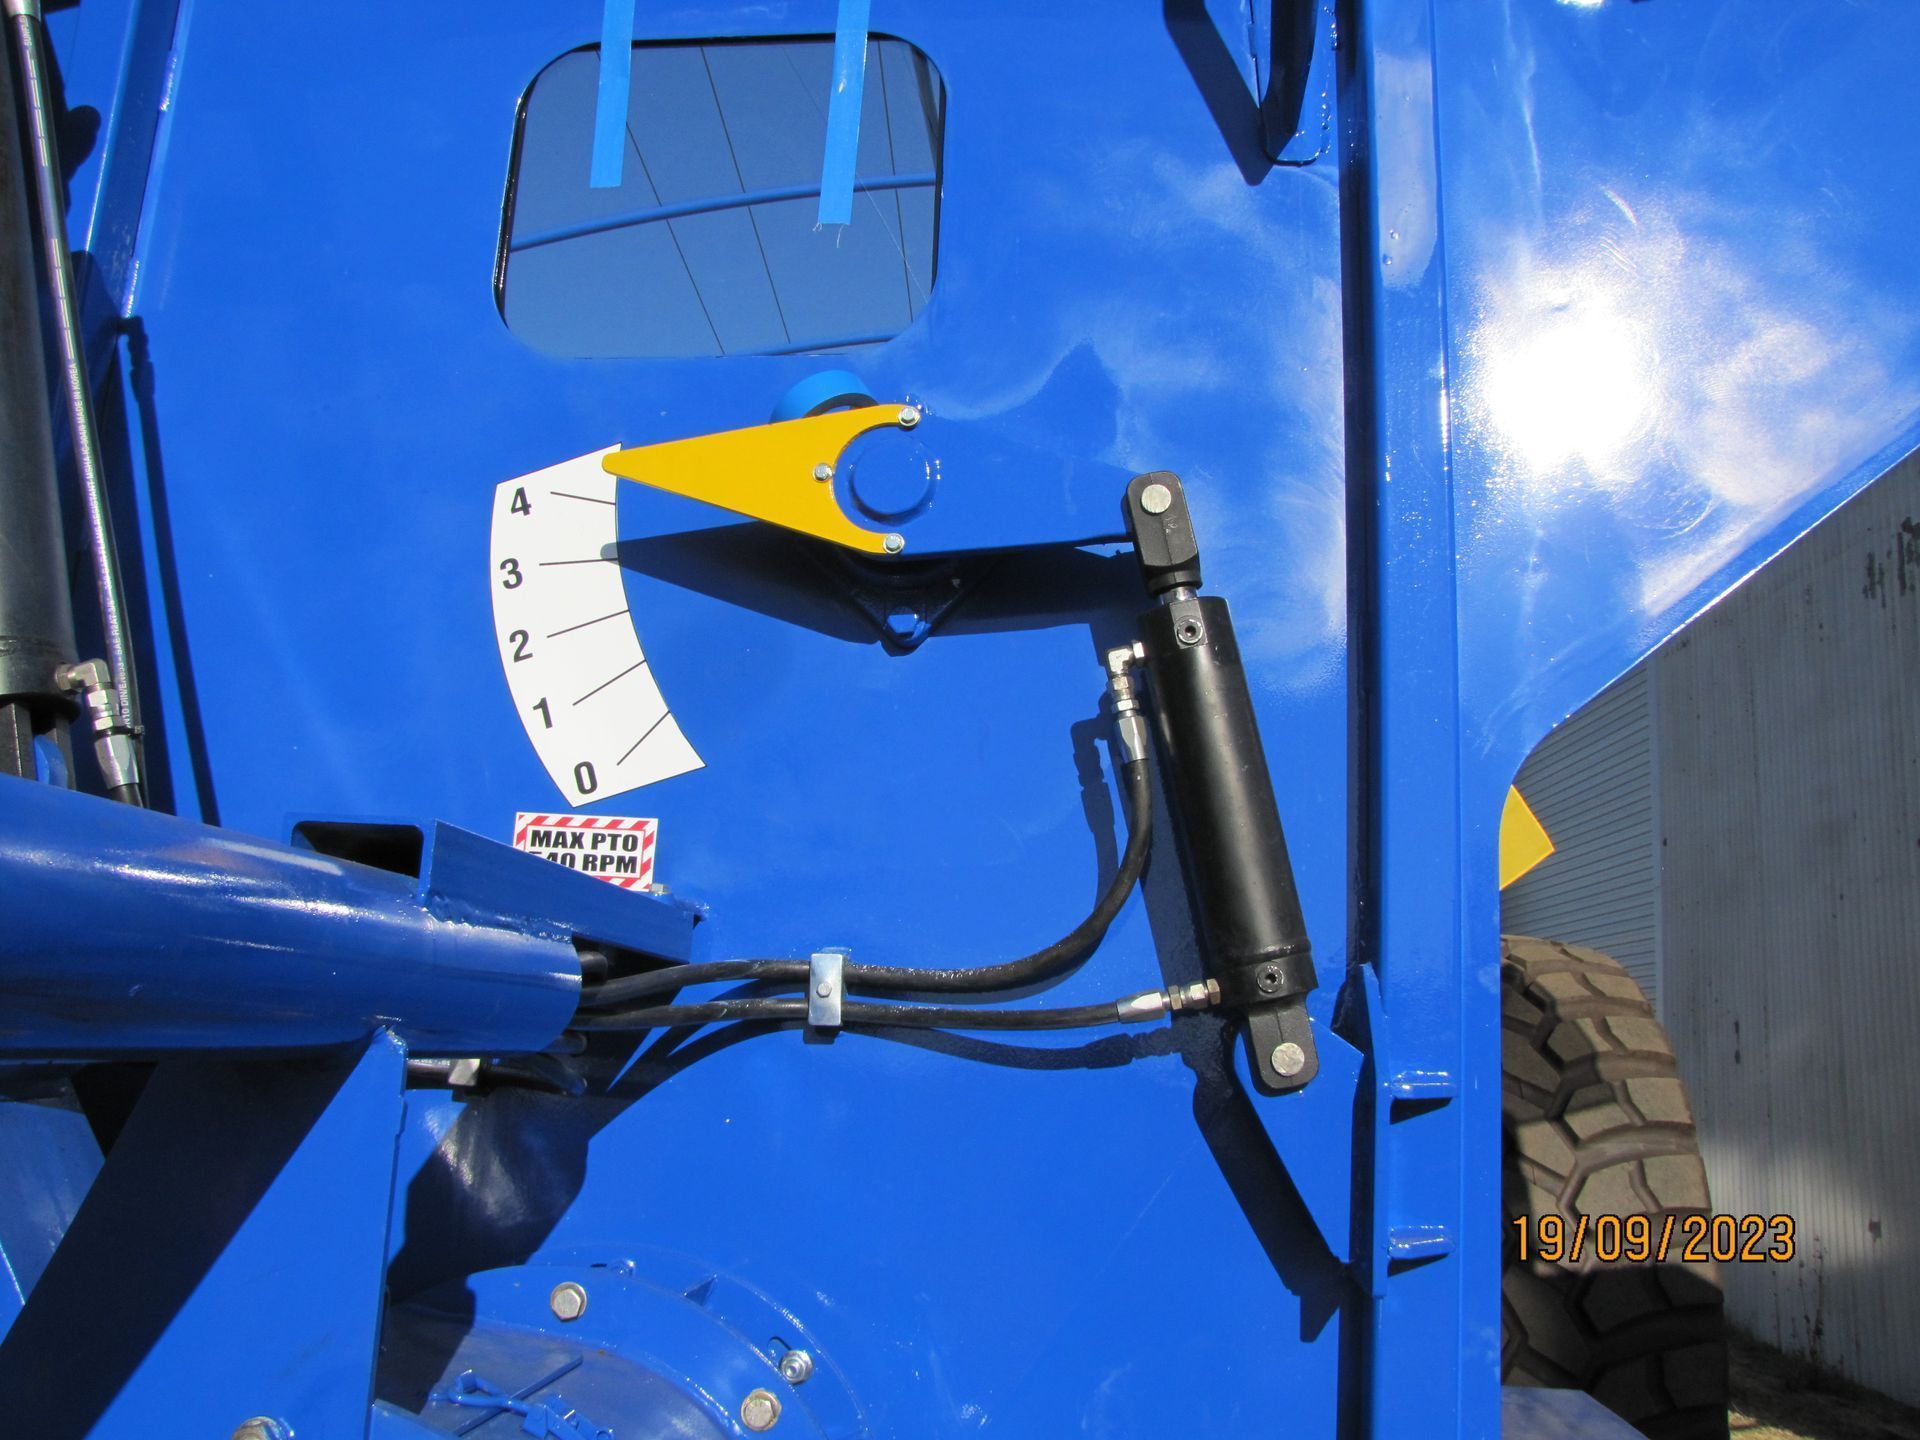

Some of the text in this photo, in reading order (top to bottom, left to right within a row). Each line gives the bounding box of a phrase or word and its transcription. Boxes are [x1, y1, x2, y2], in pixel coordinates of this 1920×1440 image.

[70, 362, 80, 390] KOREA
[73, 390, 82, 400] IN
[75, 400, 85, 423] MADE
[510, 487, 532, 516] 4
[500, 557, 523, 589] 3
[509, 629, 533, 663] 2
[532, 697, 553, 729] 1
[573, 760, 598, 795] 0
[530, 829, 639, 853] MAX PTO
[528, 851, 638, 874] 40 RPM
